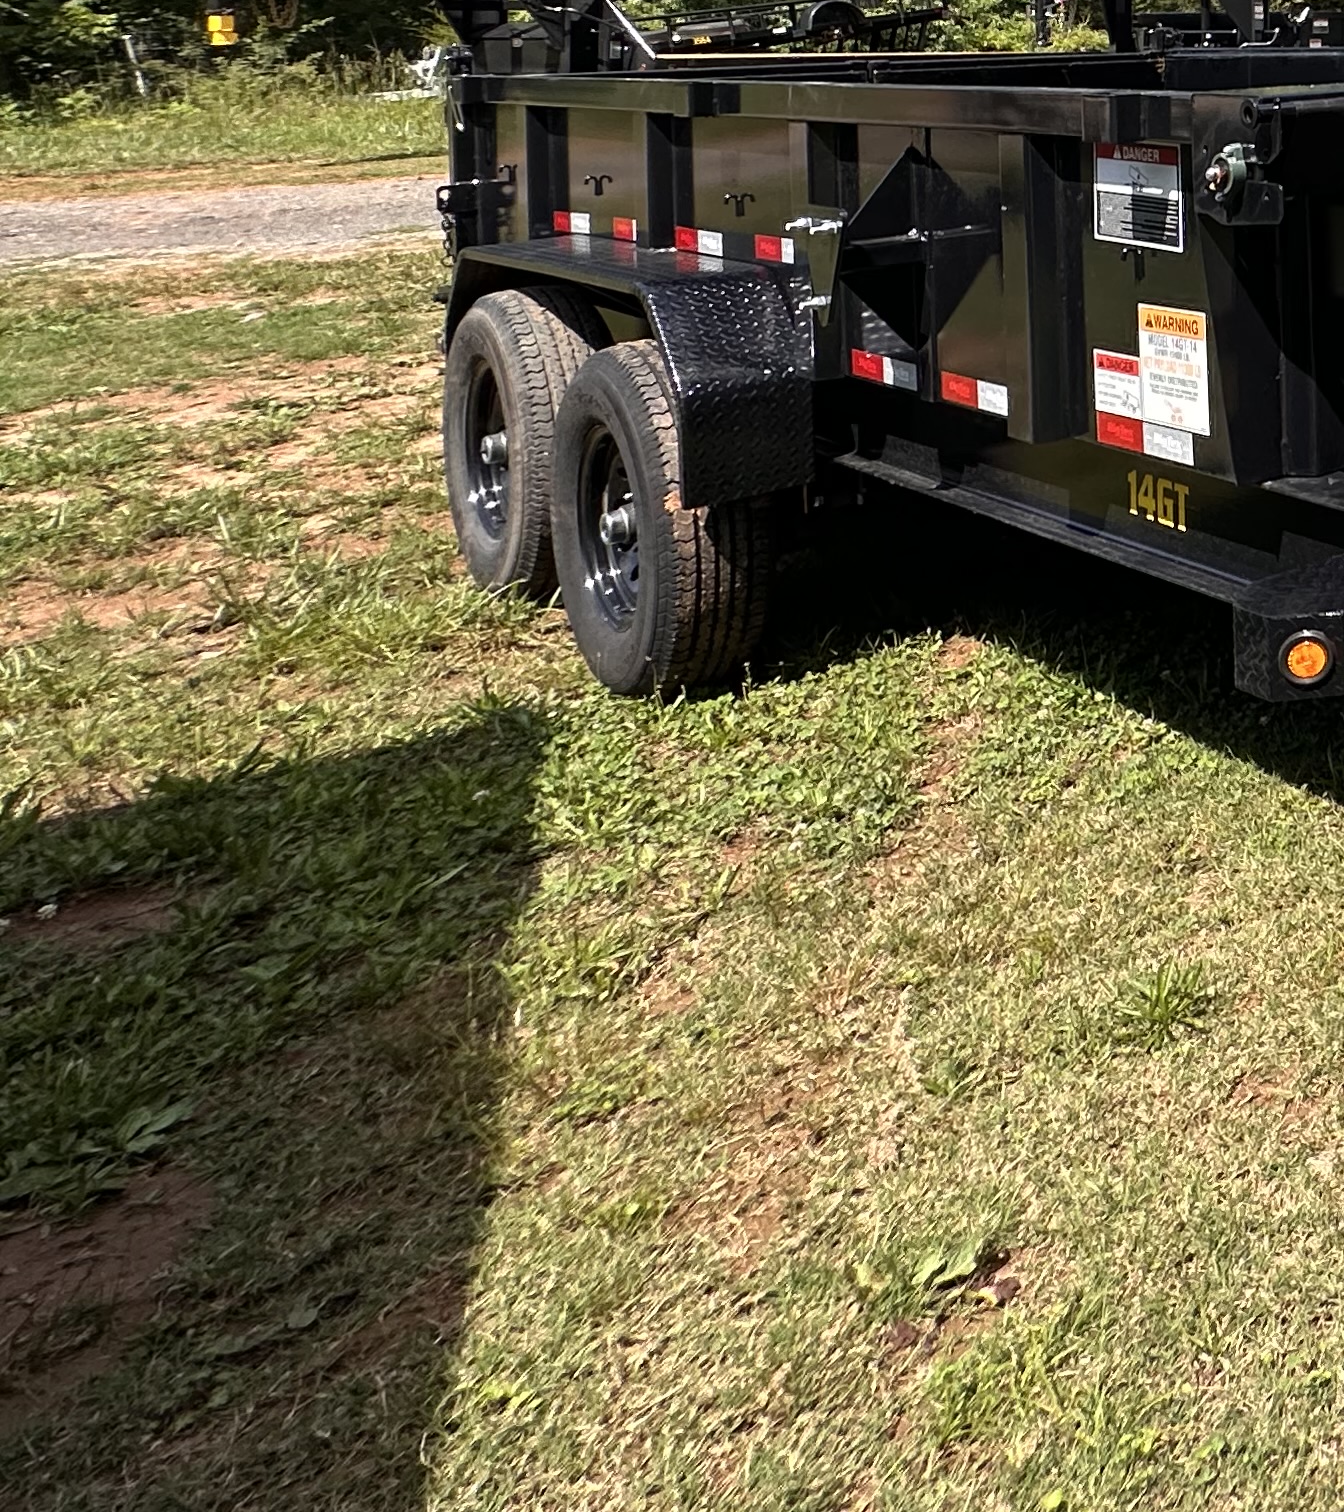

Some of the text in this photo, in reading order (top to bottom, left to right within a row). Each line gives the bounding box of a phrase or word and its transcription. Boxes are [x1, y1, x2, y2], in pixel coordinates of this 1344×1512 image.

[1122, 146, 1160, 163] DANGER
[1153, 313, 1199, 336] WARNING
[1127, 469, 1190, 533] 14GT
